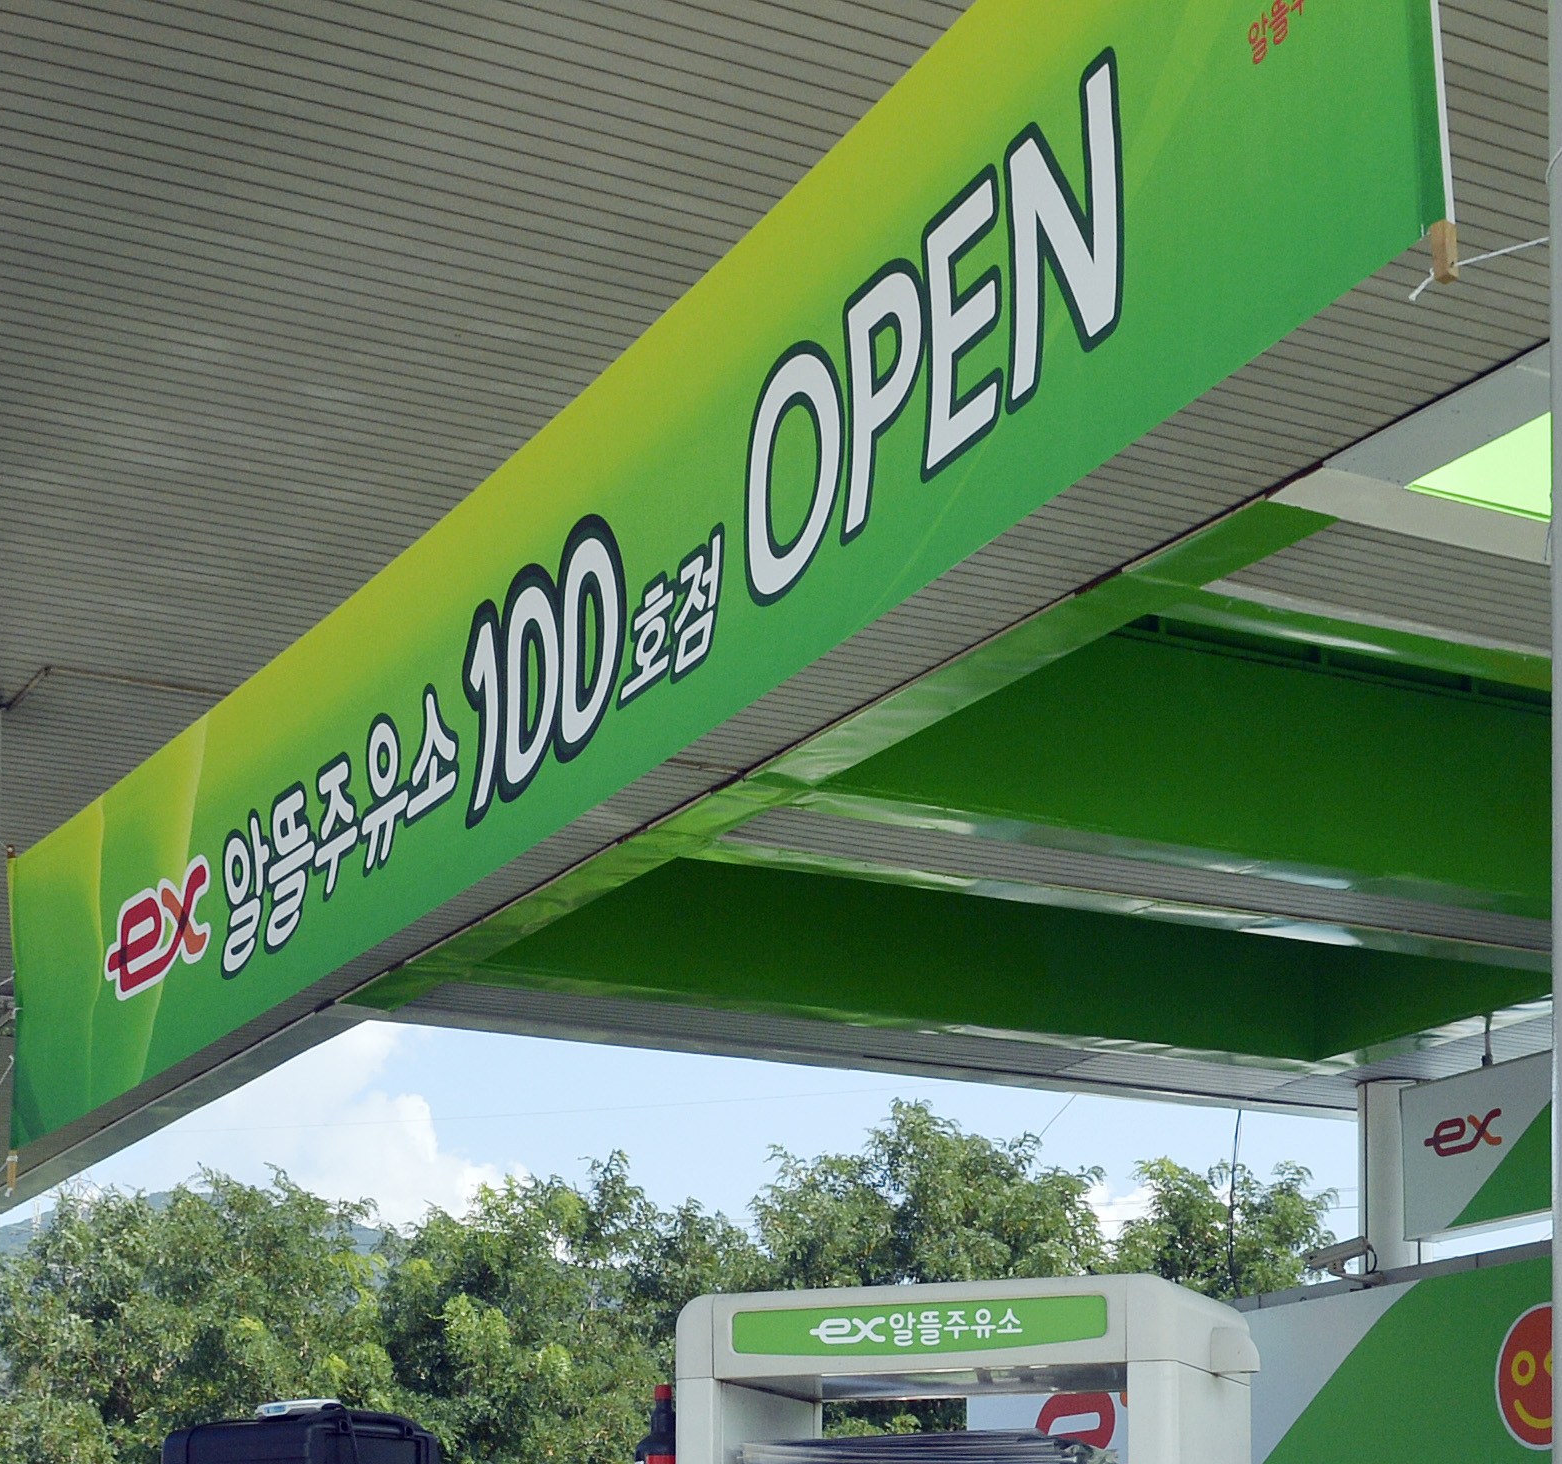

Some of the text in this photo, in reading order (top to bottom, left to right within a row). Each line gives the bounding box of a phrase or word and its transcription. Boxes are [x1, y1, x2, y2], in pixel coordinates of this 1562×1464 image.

[106, 853, 210, 998] ex
[221, 684, 459, 979] 알뜰주유소
[743, 46, 1121, 607] OPEN
[1423, 1108, 1503, 1158] ex
[888, 1308, 1023, 1346] 알뜰주유소
